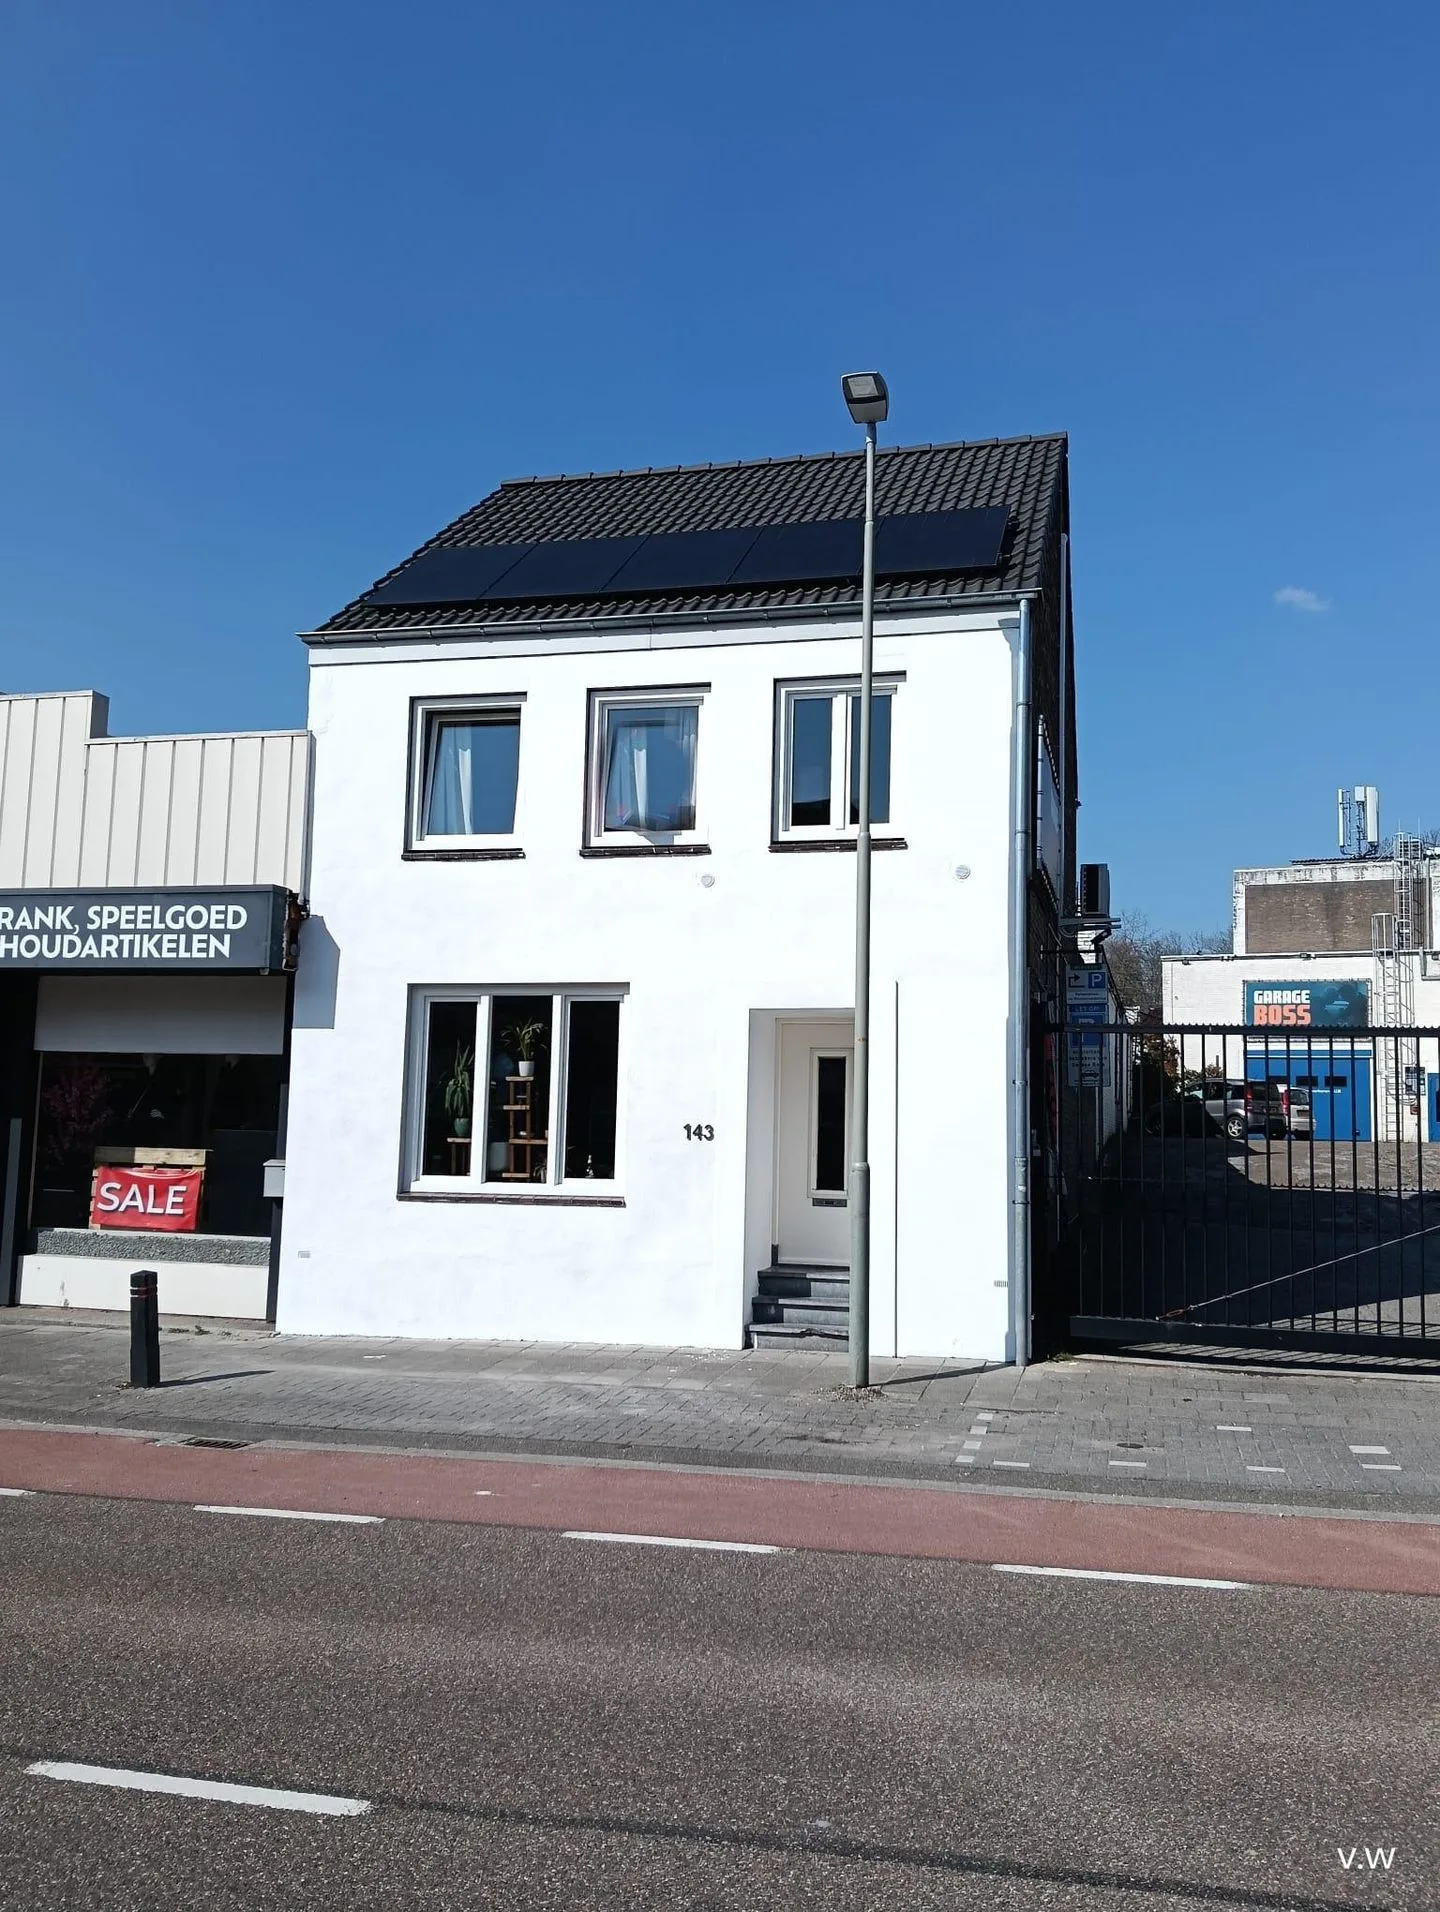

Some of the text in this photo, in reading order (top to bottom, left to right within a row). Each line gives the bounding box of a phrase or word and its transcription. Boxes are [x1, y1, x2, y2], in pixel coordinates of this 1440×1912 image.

[0, 905, 248, 935] RANK, SPEELGOED
[0, 933, 231, 959] HOUDARTIKELEN
[1091, 973, 1103, 987] P
[1253, 989, 1311, 1004] GARAGE
[1253, 1004, 1312, 1026] BOSS
[683, 1123, 715, 1142] 143
[97, 1182, 187, 1214] SALE
